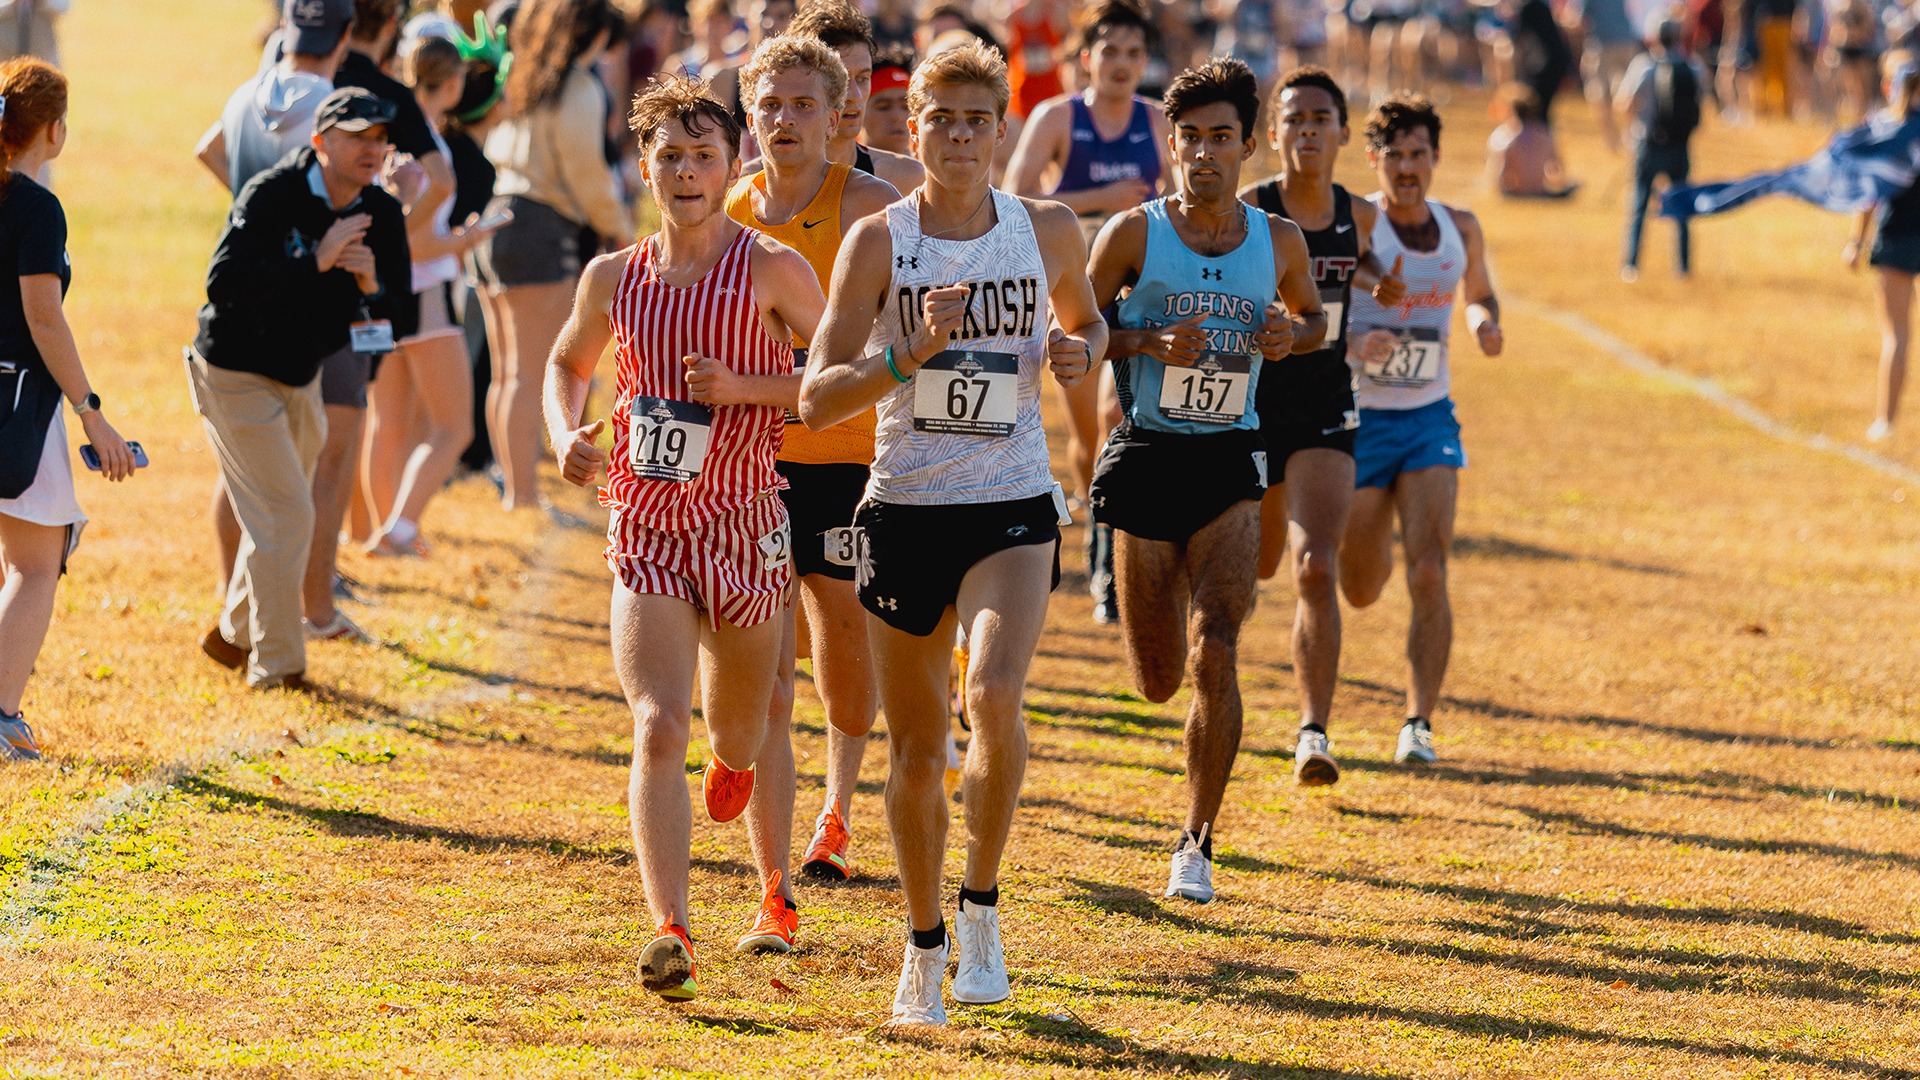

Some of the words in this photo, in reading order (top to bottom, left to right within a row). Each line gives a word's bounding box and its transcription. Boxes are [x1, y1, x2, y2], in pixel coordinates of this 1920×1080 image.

[1309, 256, 1357, 282] IT
[898, 278, 1038, 341] OKOSH
[1163, 291, 1255, 325] JOHNS
[1144, 317, 1260, 356] KINS
[1381, 346, 1427, 378] 237
[946, 378, 991, 420] 67
[1180, 375, 1233, 412] 157
[635, 423, 687, 468] 219
